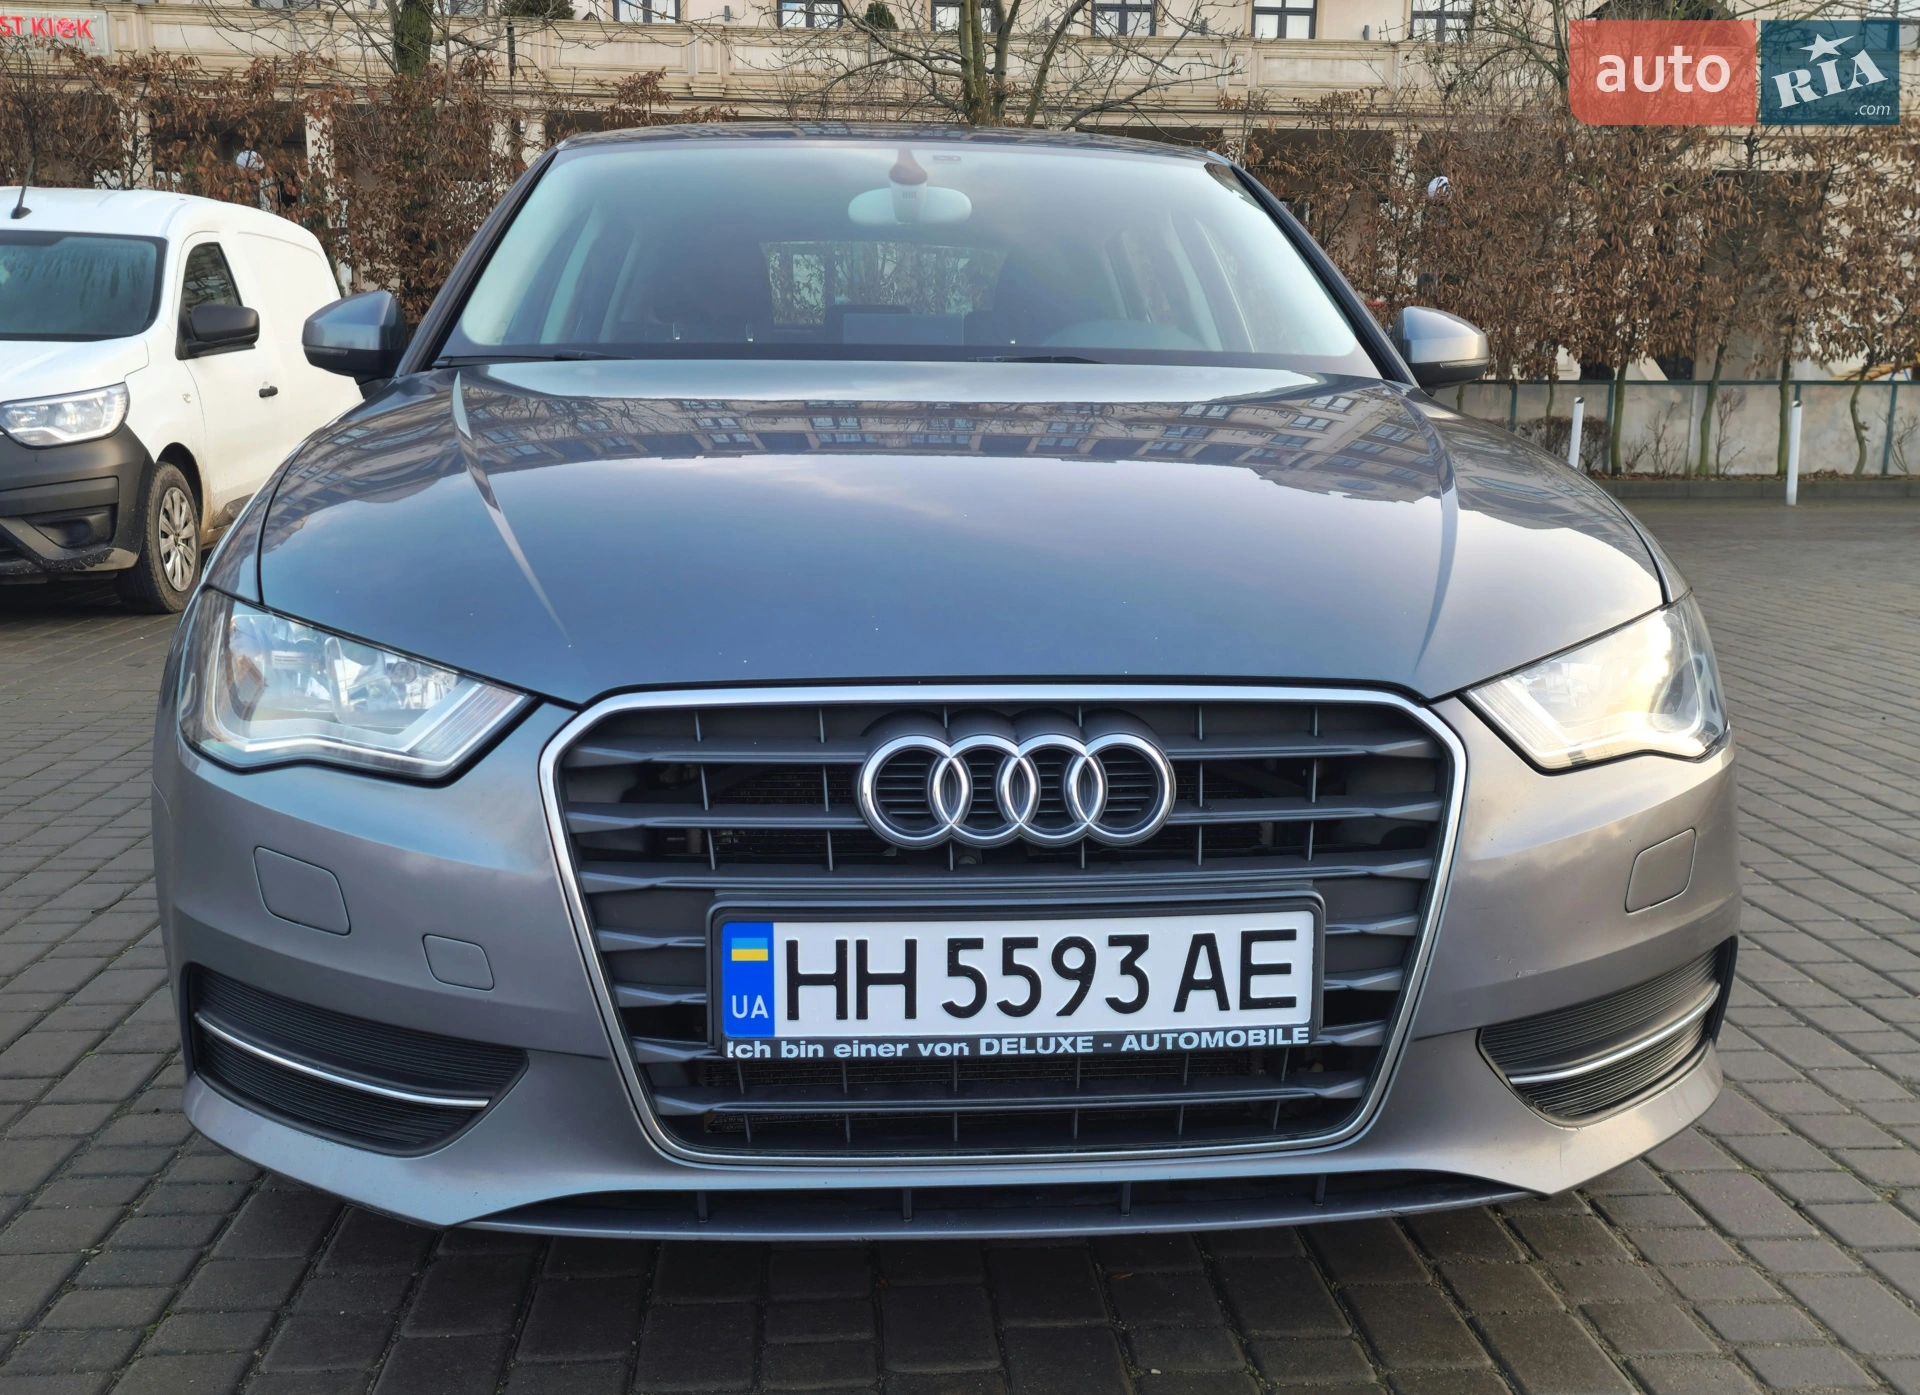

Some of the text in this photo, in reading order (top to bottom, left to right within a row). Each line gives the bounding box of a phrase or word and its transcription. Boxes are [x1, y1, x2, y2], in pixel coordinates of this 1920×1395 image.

[786, 928, 1298, 1021] HH 5593 AE
[731, 994, 769, 1019] UA
[727, 1041, 771, 1058] Ich
[781, 1041, 824, 1058] bin
[833, 1040, 908, 1058] einer
[917, 1042, 970, 1057] von
[979, 1035, 1094, 1056] DELUXE
[1120, 1026, 1310, 1052] AUTOMOBILE
